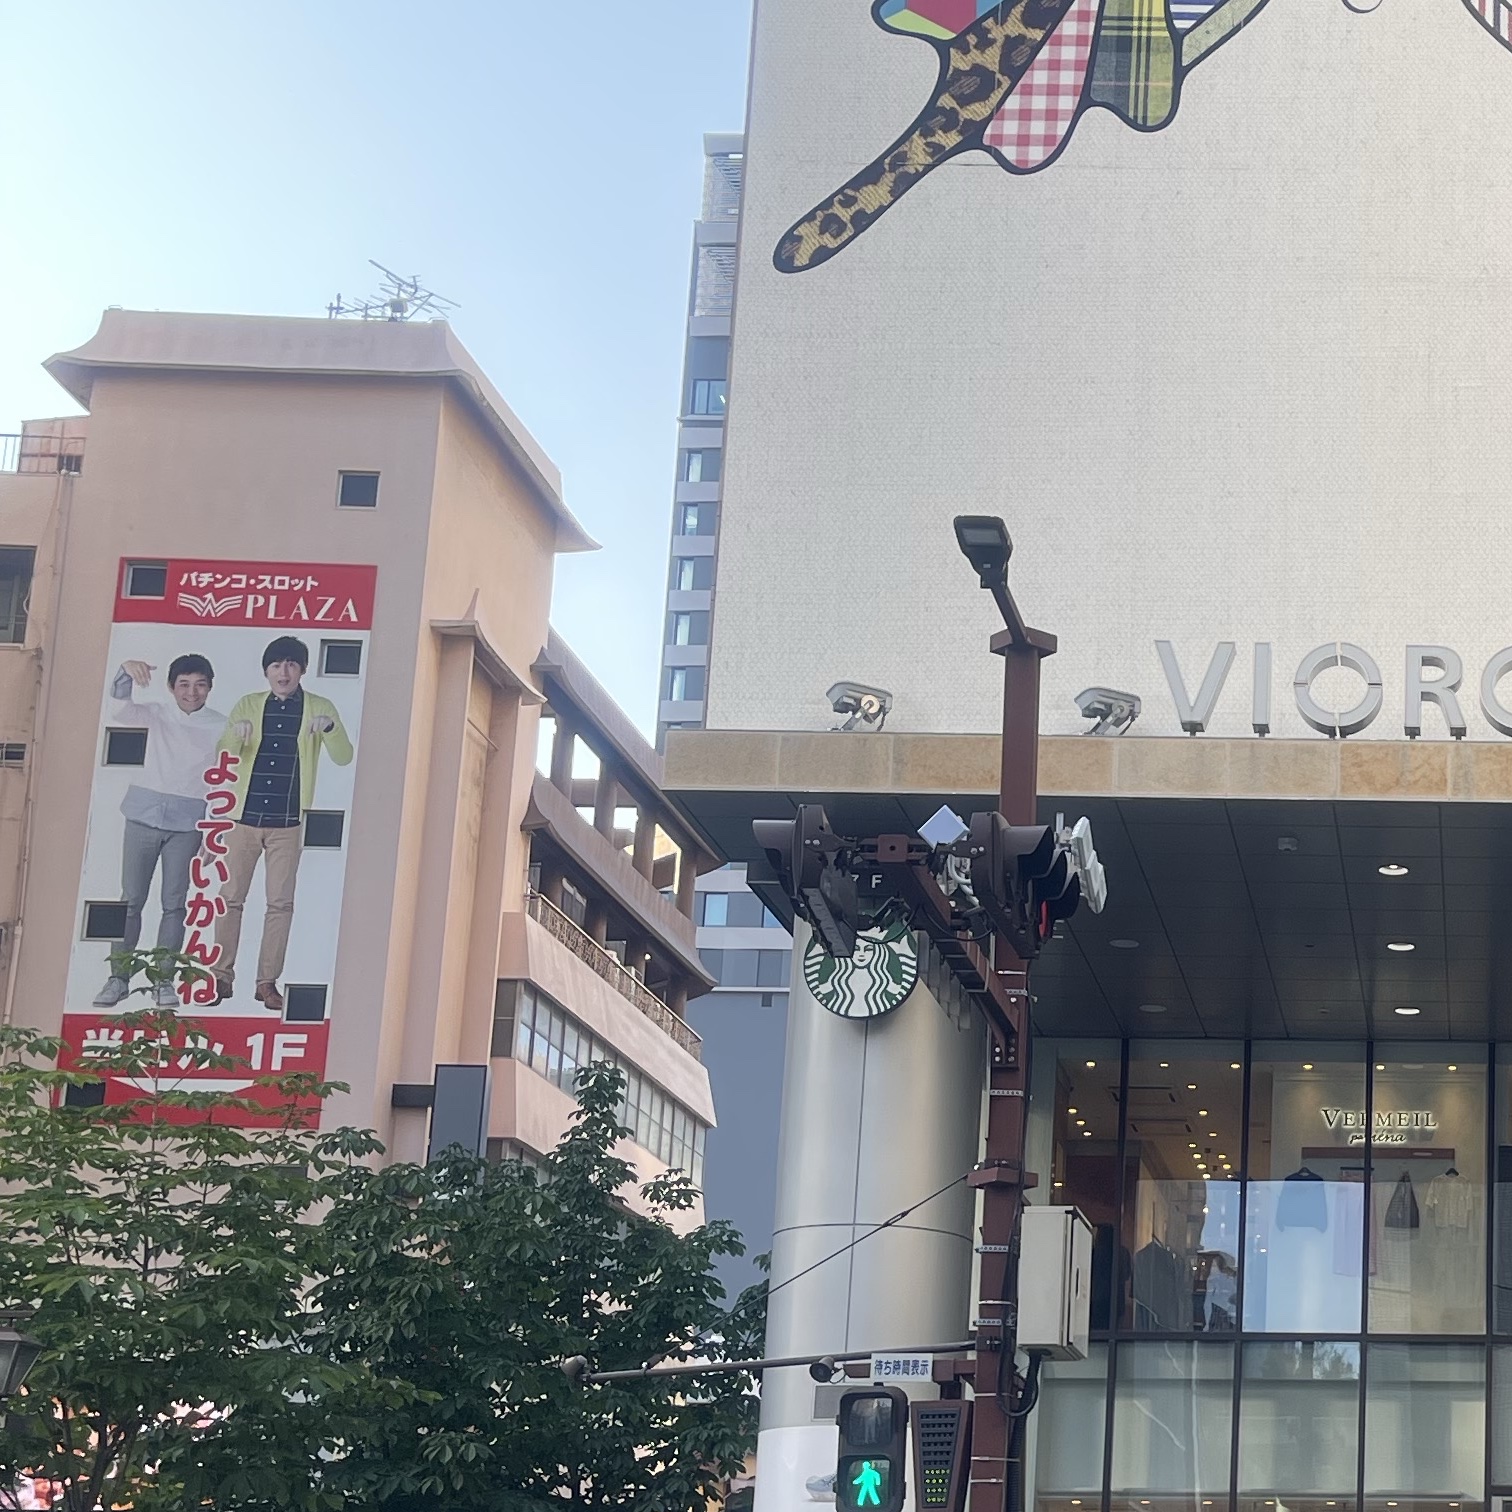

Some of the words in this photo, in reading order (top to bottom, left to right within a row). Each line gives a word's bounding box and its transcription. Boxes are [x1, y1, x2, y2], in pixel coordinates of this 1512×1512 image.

[179, 571, 319, 592] パチンコ・スロット
[244, 594, 359, 622] PLAZA
[176, 750, 242, 1006] よっていかんね
[246, 1033, 308, 1071] 1F
[874, 1359, 929, 1376] 待ち時間表示
